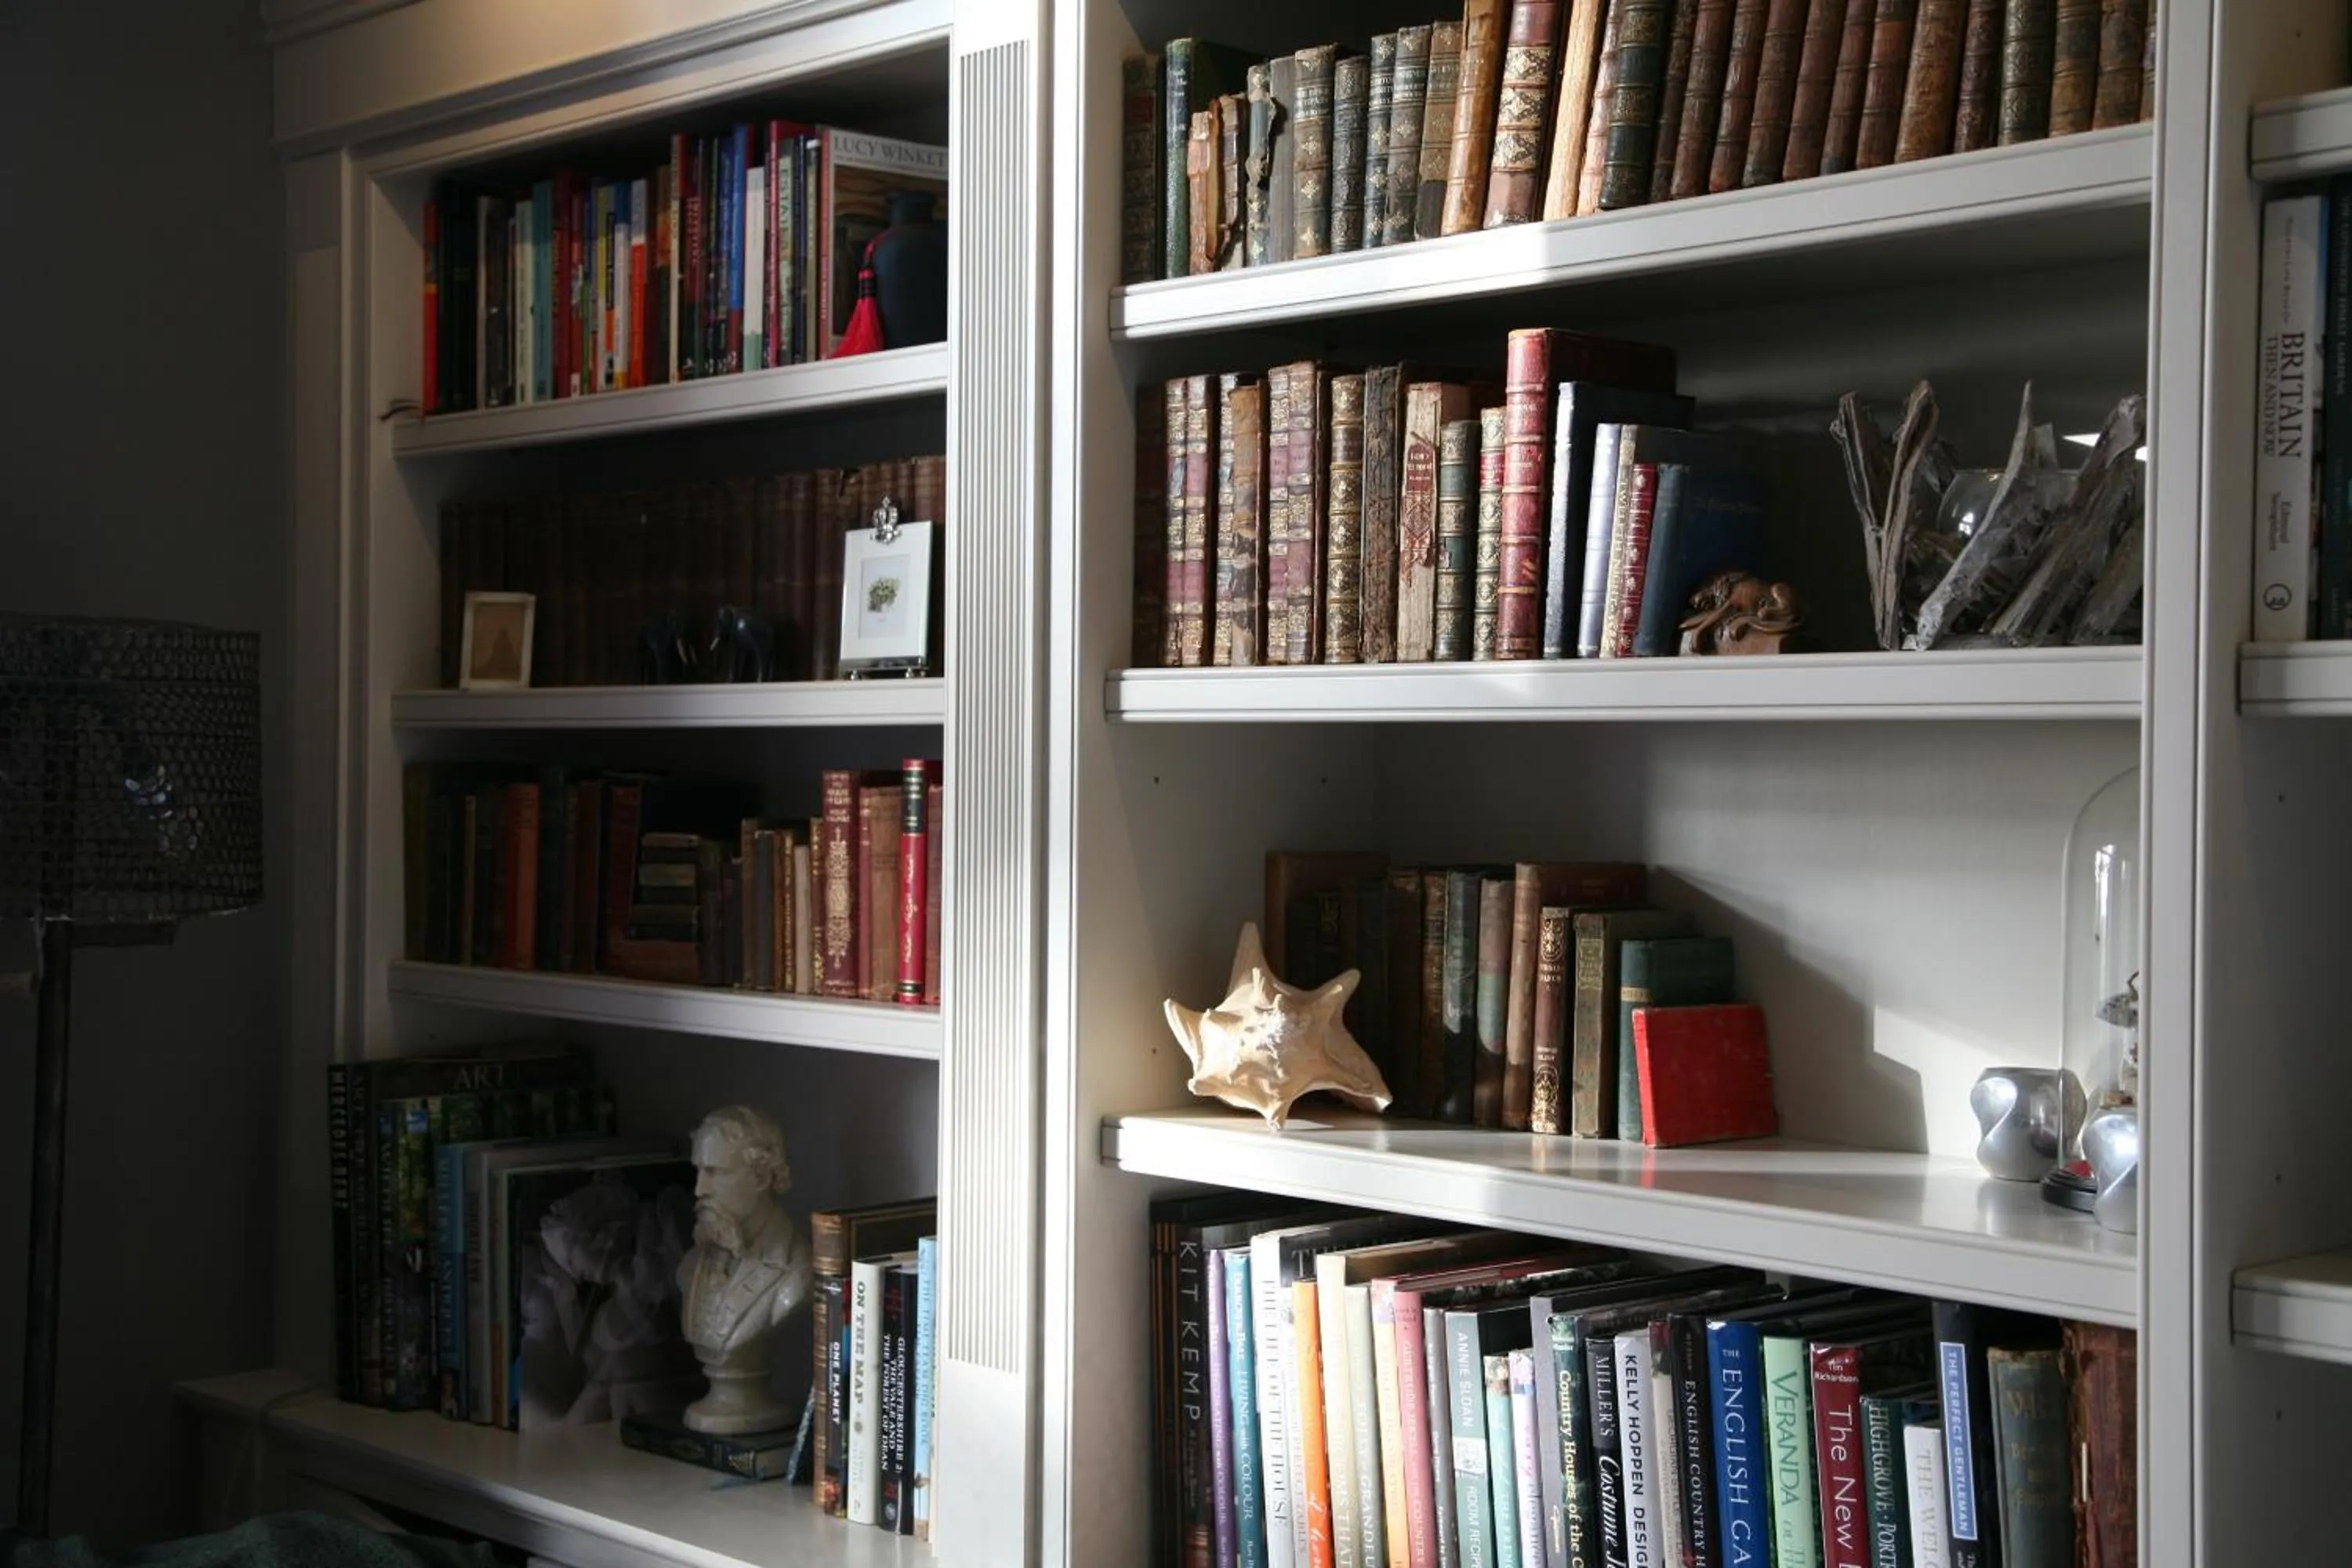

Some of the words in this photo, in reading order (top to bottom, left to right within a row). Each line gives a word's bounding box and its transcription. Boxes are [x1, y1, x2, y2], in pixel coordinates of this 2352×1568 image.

[833, 136, 879, 157] LUCY
[2265, 333, 2278, 380] THEN
[2264, 383, 2278, 419] AND
[2278, 331, 2307, 459] BRITAIN
[2262, 421, 2276, 458] NOW
[856, 1280, 866, 1308] ON
[1179, 1240, 1200, 1301] KIT
[1261, 1279, 1278, 1312] THE
[833, 1341, 841, 1368] ONE
[855, 1312, 866, 1356] THE
[1457, 1332, 1471, 1377] ANNIE
[1722, 1349, 1740, 1358] THE
[855, 1359, 865, 1404] MAP
[882, 1363, 891, 1412] FOREST
[1180, 1319, 1201, 1421] KEMP
[1268, 1374, 1282, 1398] OF
[1623, 1354, 1641, 1411] KELLY
[1947, 1352, 1958, 1377] THE
[832, 1373, 842, 1427] PLANET
[897, 1336, 906, 1461] GLOUCESTERSHIRE
[1238, 1370, 1249, 1427] LIVING
[1269, 1406, 1283, 1443] THE
[1460, 1380, 1474, 1427] SLOAN
[1558, 1370, 1573, 1437] Country
[1595, 1355, 1615, 1437] MILLER'S
[1685, 1379, 1700, 1459] ENGLISH
[1949, 1381, 1963, 1442] PERFECT
[1403, 1340, 1414, 1406] GERTRUDE
[1413, 1499, 1425, 1565] COUNTRY
[1627, 1416, 1645, 1497] HOPPEN
[1721, 1368, 1749, 1505] ENGLISH
[1771, 1369, 1801, 1506] VERANDA
[1828, 1404, 1854, 1462] The
[1868, 1404, 1895, 1512] HIGHGROVE
[1218, 1471, 1227, 1525] COLOUR
[1242, 1452, 1254, 1521] COLOUR
[1271, 1454, 1290, 1529] HOUSE
[1563, 1440, 1578, 1499] Houses
[1915, 1449, 1934, 1499] THE
[1952, 1446, 1969, 1531] GENTLEMAN
[1467, 1485, 1480, 1525] ROOM
[1567, 1503, 1584, 1523] of
[1598, 1454, 1621, 1548] Costume
[1689, 1463, 1705, 1550] COUNTRY
[1833, 1475, 1858, 1551] New
[1336, 1510, 1353, 1568] THAT
[1570, 1524, 1583, 1552] the
[1730, 1519, 1753, 1565] GA
